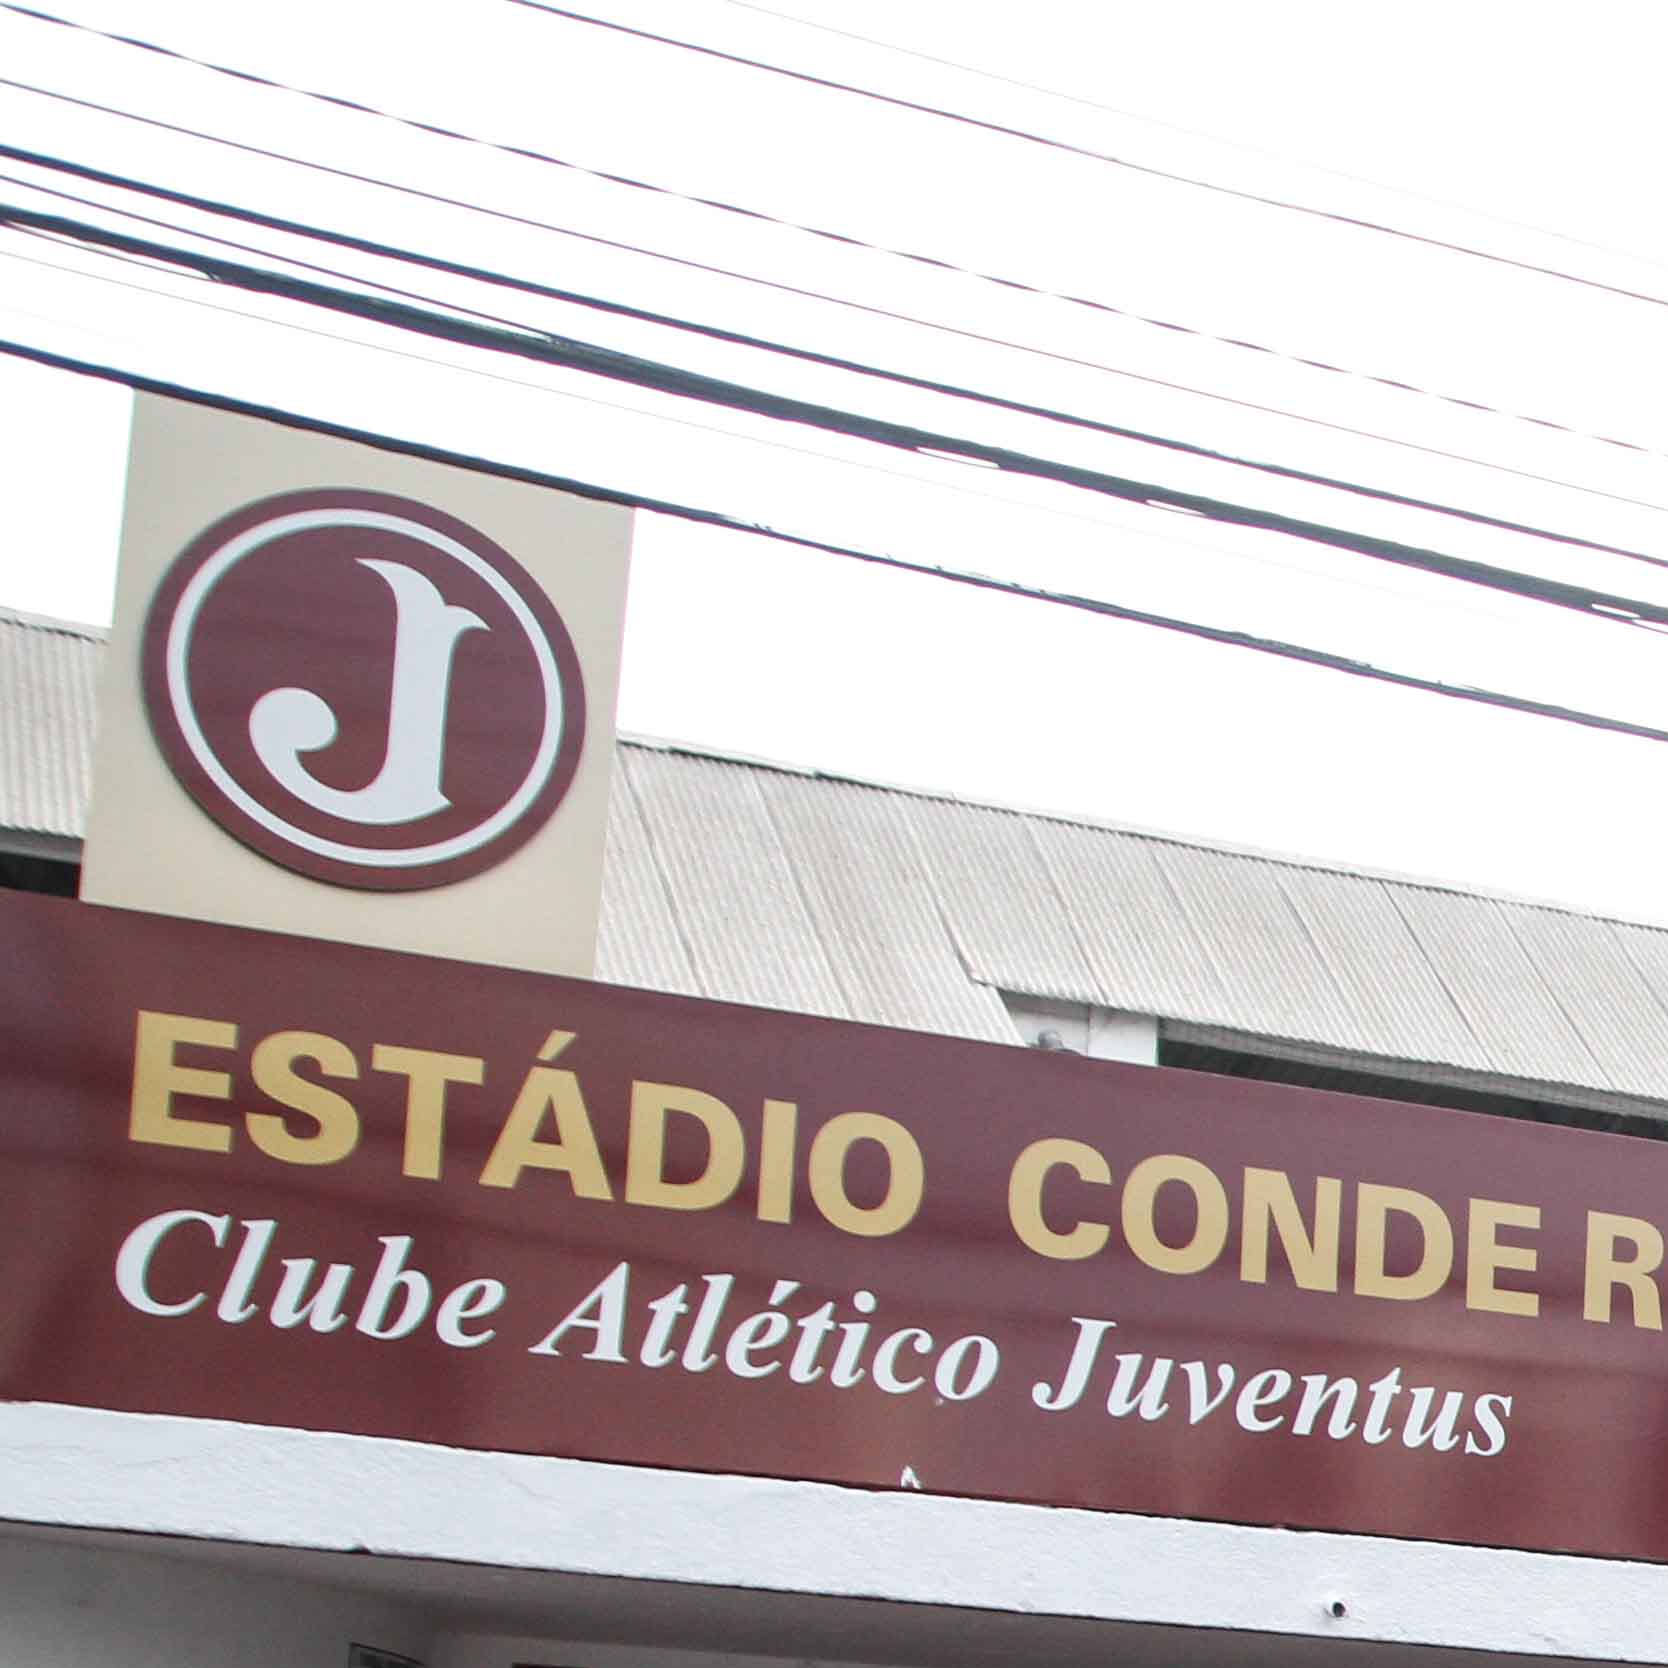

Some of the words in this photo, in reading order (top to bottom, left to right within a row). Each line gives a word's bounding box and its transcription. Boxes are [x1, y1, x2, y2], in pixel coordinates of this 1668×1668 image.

[249, 557, 491, 826] J
[127, 1008, 925, 1238] ESTÁDIO
[1007, 1136, 1541, 1319] CONDE
[113, 1208, 508, 1349] Clube
[528, 1260, 1000, 1401] Atlético
[1031, 1315, 1514, 1458] Juventus
